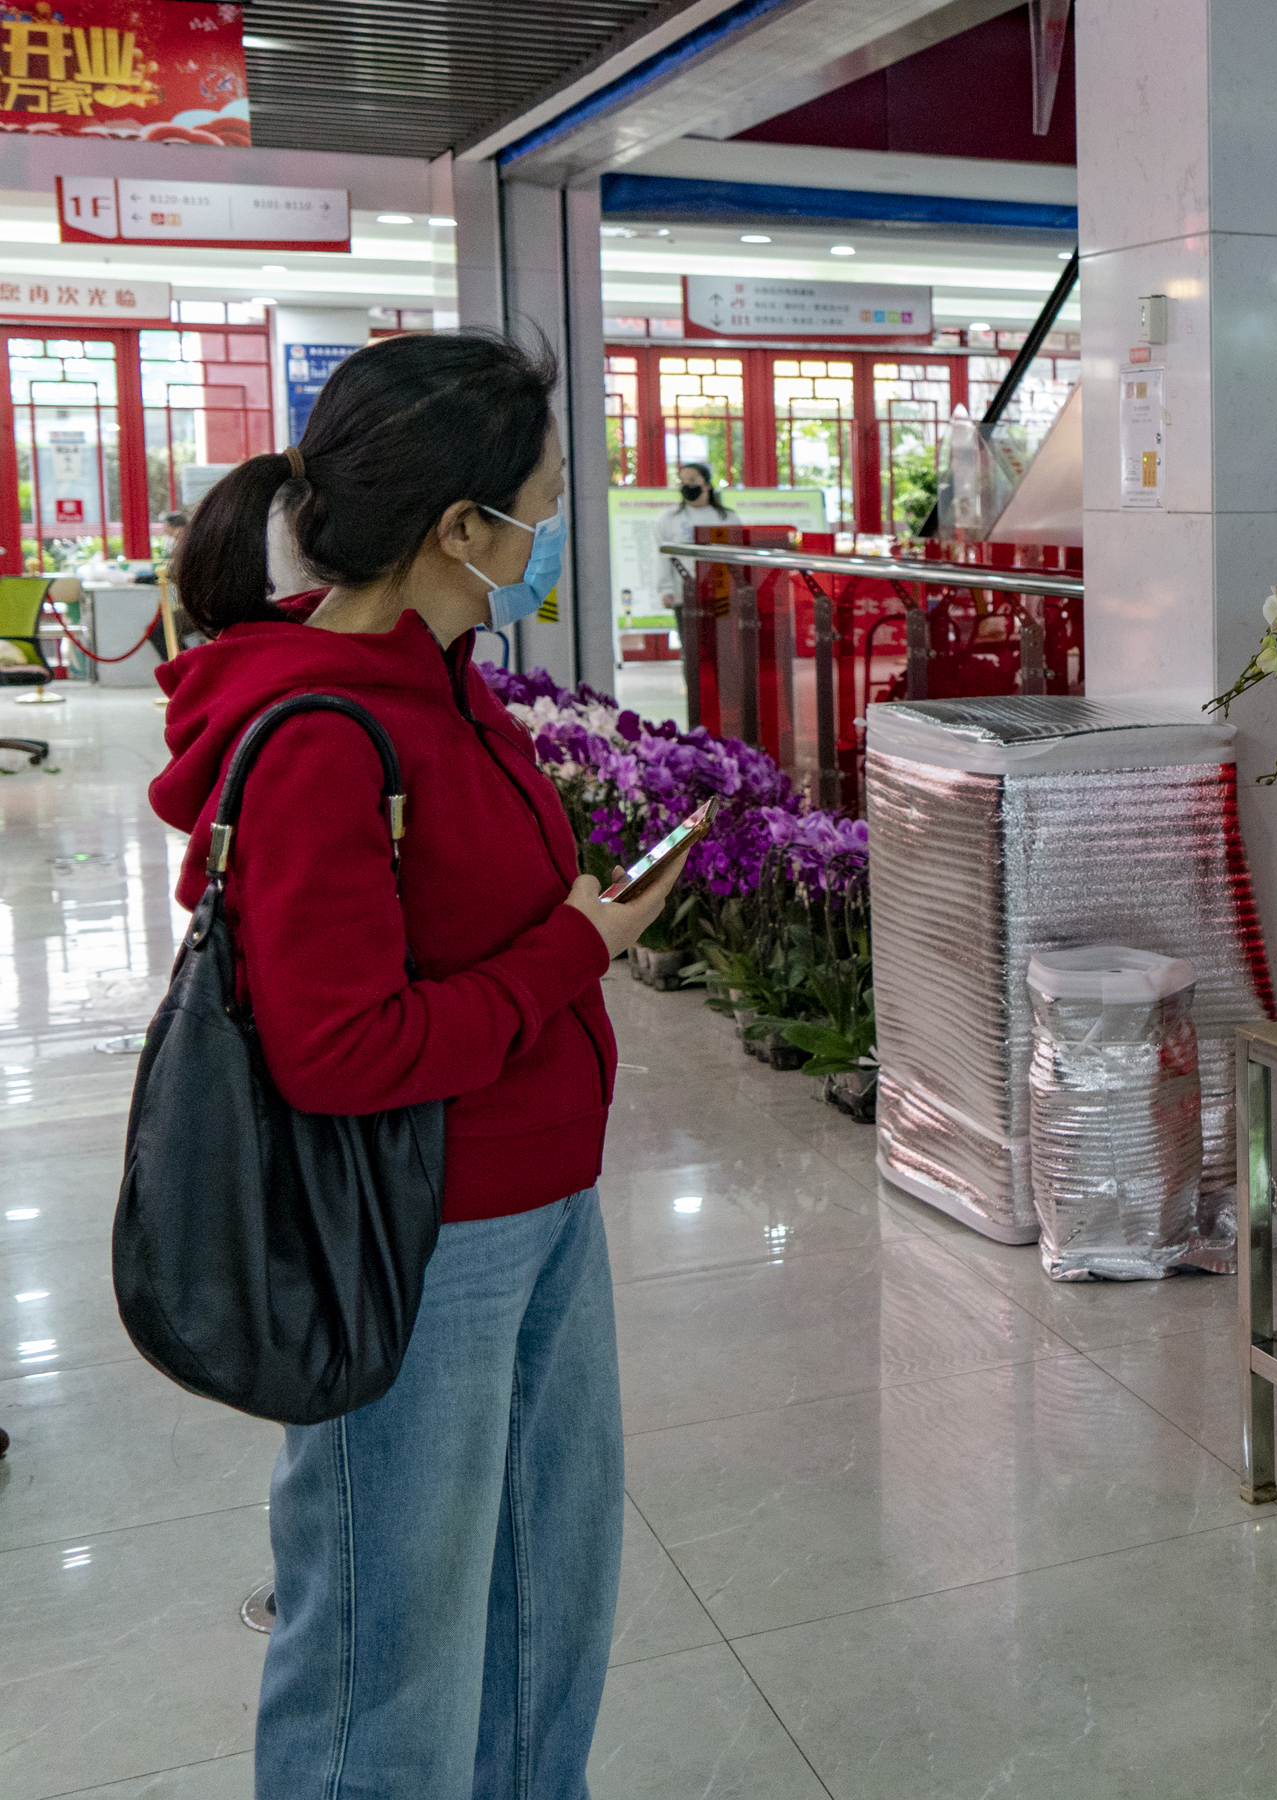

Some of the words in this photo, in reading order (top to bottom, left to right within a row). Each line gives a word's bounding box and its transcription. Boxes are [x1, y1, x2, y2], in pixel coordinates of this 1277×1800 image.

[69, 195, 112, 218] 1F
[0, 282, 137, 309] 您再次光临
